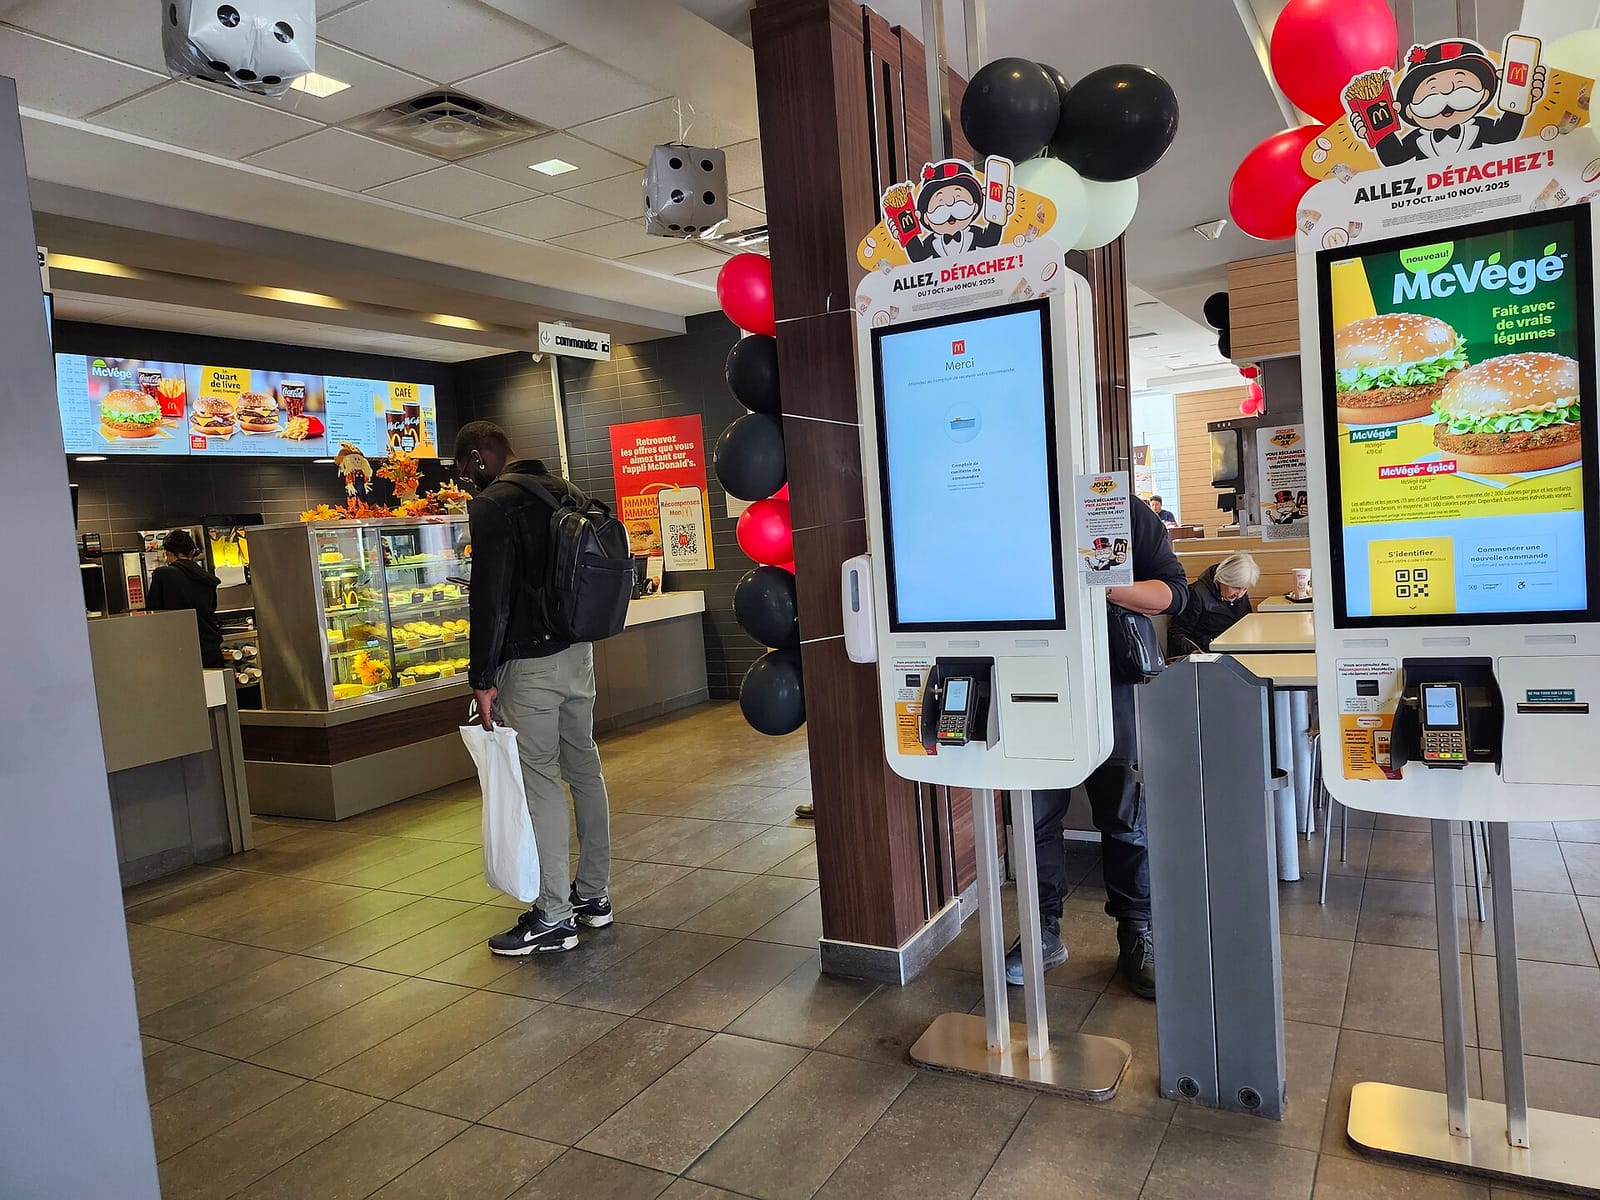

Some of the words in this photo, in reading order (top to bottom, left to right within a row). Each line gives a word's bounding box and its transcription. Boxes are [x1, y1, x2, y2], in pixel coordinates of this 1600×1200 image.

[1354, 178, 1424, 204] ALLEZ,
[1391, 200, 1404, 210] DU
[1406, 198, 1412, 207] 7
[1413, 195, 1433, 205] OCT.
[1435, 194, 1446, 202] au
[1448, 190, 1458, 199] 10
[1460, 187, 1483, 198] NOV.
[1486, 180, 1509, 192] 2025
[1554, 188, 1567, 201] 100
[1405, 250, 1449, 264] nouveau!
[1393, 242, 1564, 304] McVégé
[893, 272, 938, 292] ALLEZ,
[918, 290, 926, 298] DU
[962, 282, 978, 290] NOV.
[979, 278, 996, 286] 2025
[1493, 305, 1520, 318] Fait
[1521, 302, 1556, 314] avec
[1496, 319, 1515, 331] de
[1517, 314, 1552, 328] vrais
[556, 336, 598, 351] commandez
[1494, 328, 1556, 345] légumes
[945, 358, 974, 371] Merci
[92, 367, 132, 380] McVégé
[213, 372, 237, 380] Quart
[222, 381, 240, 389] livre
[394, 386, 412, 397] CAFÉ
[636, 436, 676, 446] Retrouvez
[1274, 433, 1296, 441] JOUEZ
[1352, 430, 1392, 440] McVégé
[621, 448, 632, 456] les
[634, 446, 657, 455] offres
[674, 442, 694, 450] vous
[630, 456, 653, 464] aimez
[654, 453, 671, 462] tant
[622, 464, 646, 475] l'appli
[648, 459, 696, 471] McDonald's.
[1380, 467, 1420, 476] McVégé
[1427, 462, 1455, 472] épicé
[661, 500, 700, 508] Récompenses
[1388, 550, 1433, 558] S'identifier
